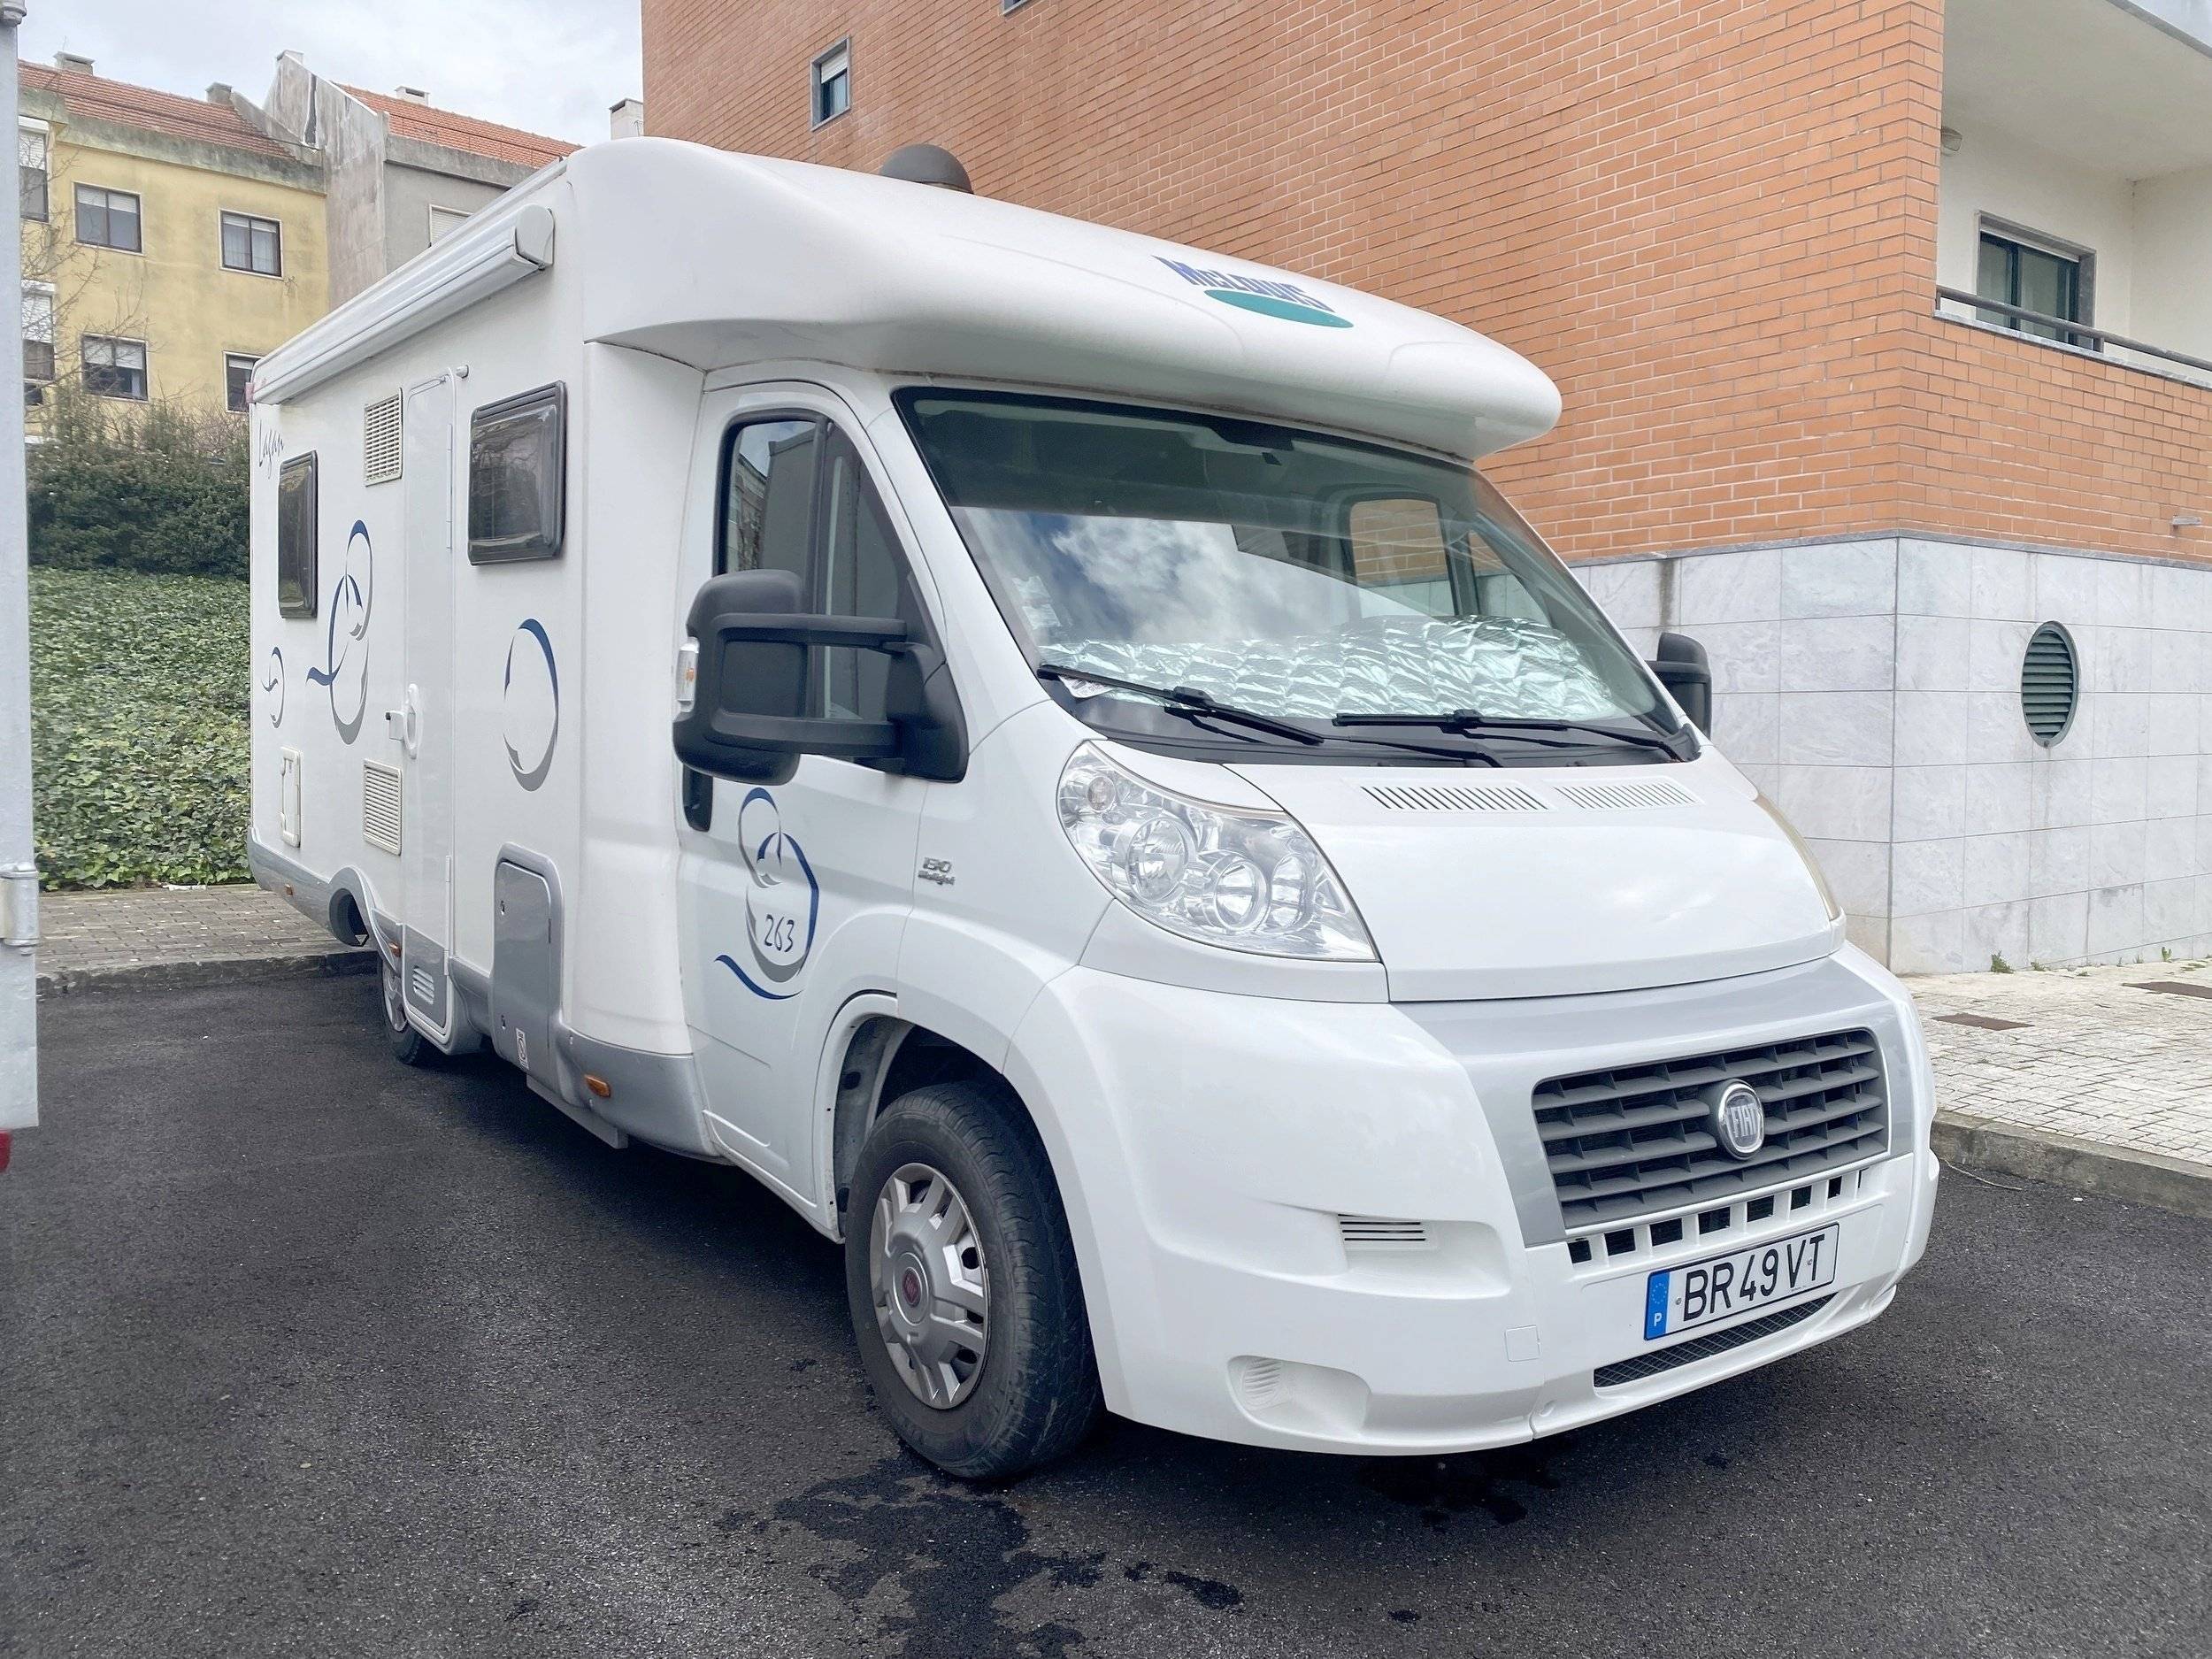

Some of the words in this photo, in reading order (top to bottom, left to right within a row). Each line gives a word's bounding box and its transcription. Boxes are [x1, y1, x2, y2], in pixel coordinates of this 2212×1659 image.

[764, 913, 795, 952] 263
[1730, 1102, 1756, 1138] FIAT
[1653, 1312, 1663, 1327] P
